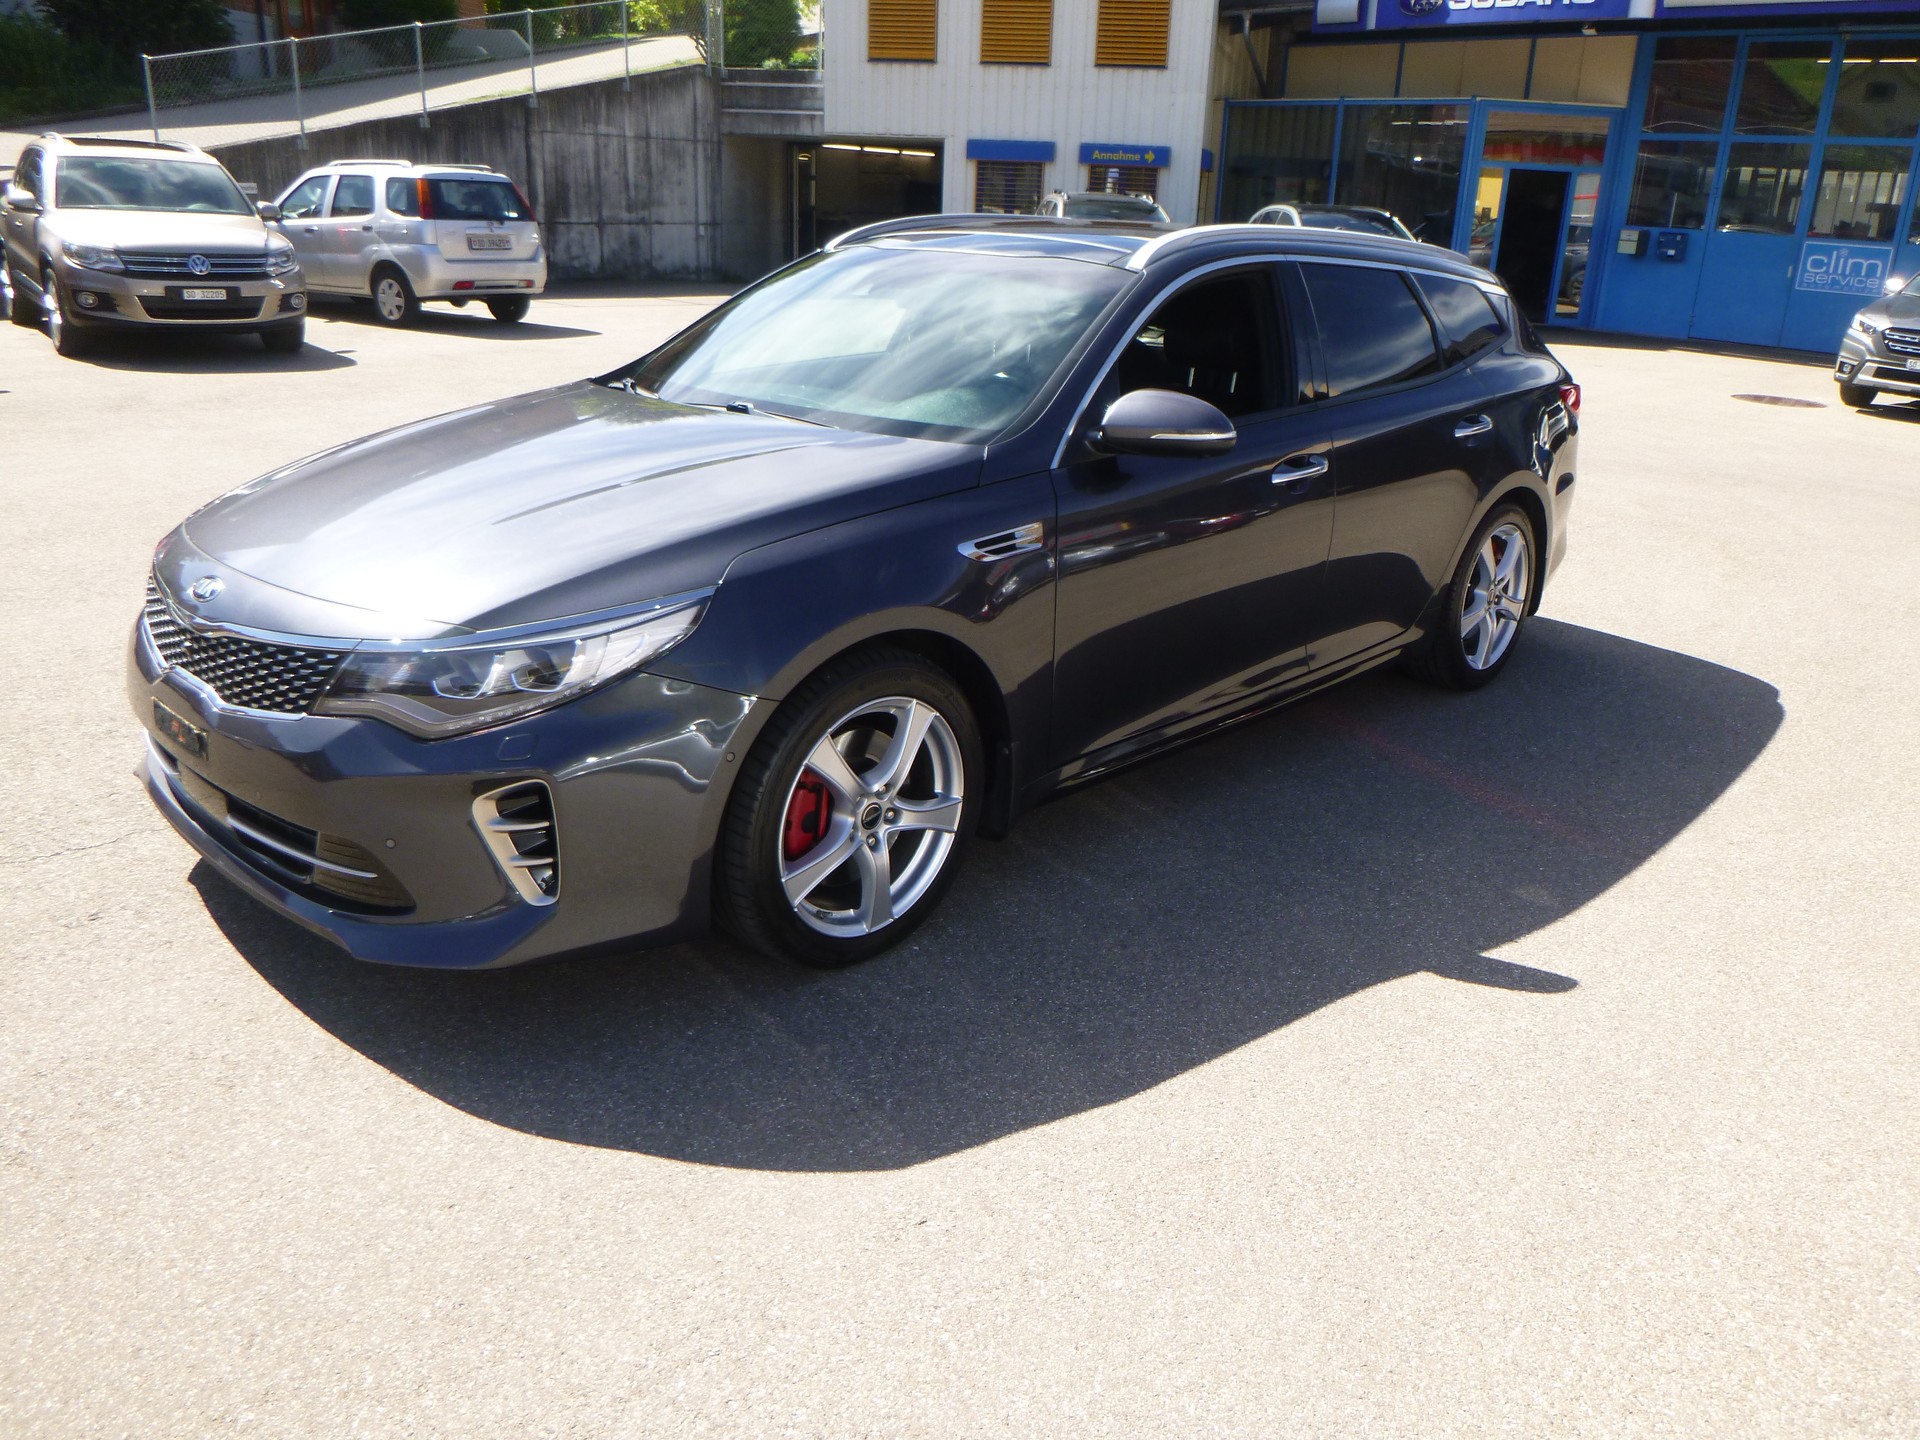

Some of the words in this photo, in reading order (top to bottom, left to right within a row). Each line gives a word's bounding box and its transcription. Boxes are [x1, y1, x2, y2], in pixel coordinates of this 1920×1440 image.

[1092, 149, 1140, 161] Annahme
[1806, 248, 1882, 278] clim
[1803, 272, 1880, 288] service
